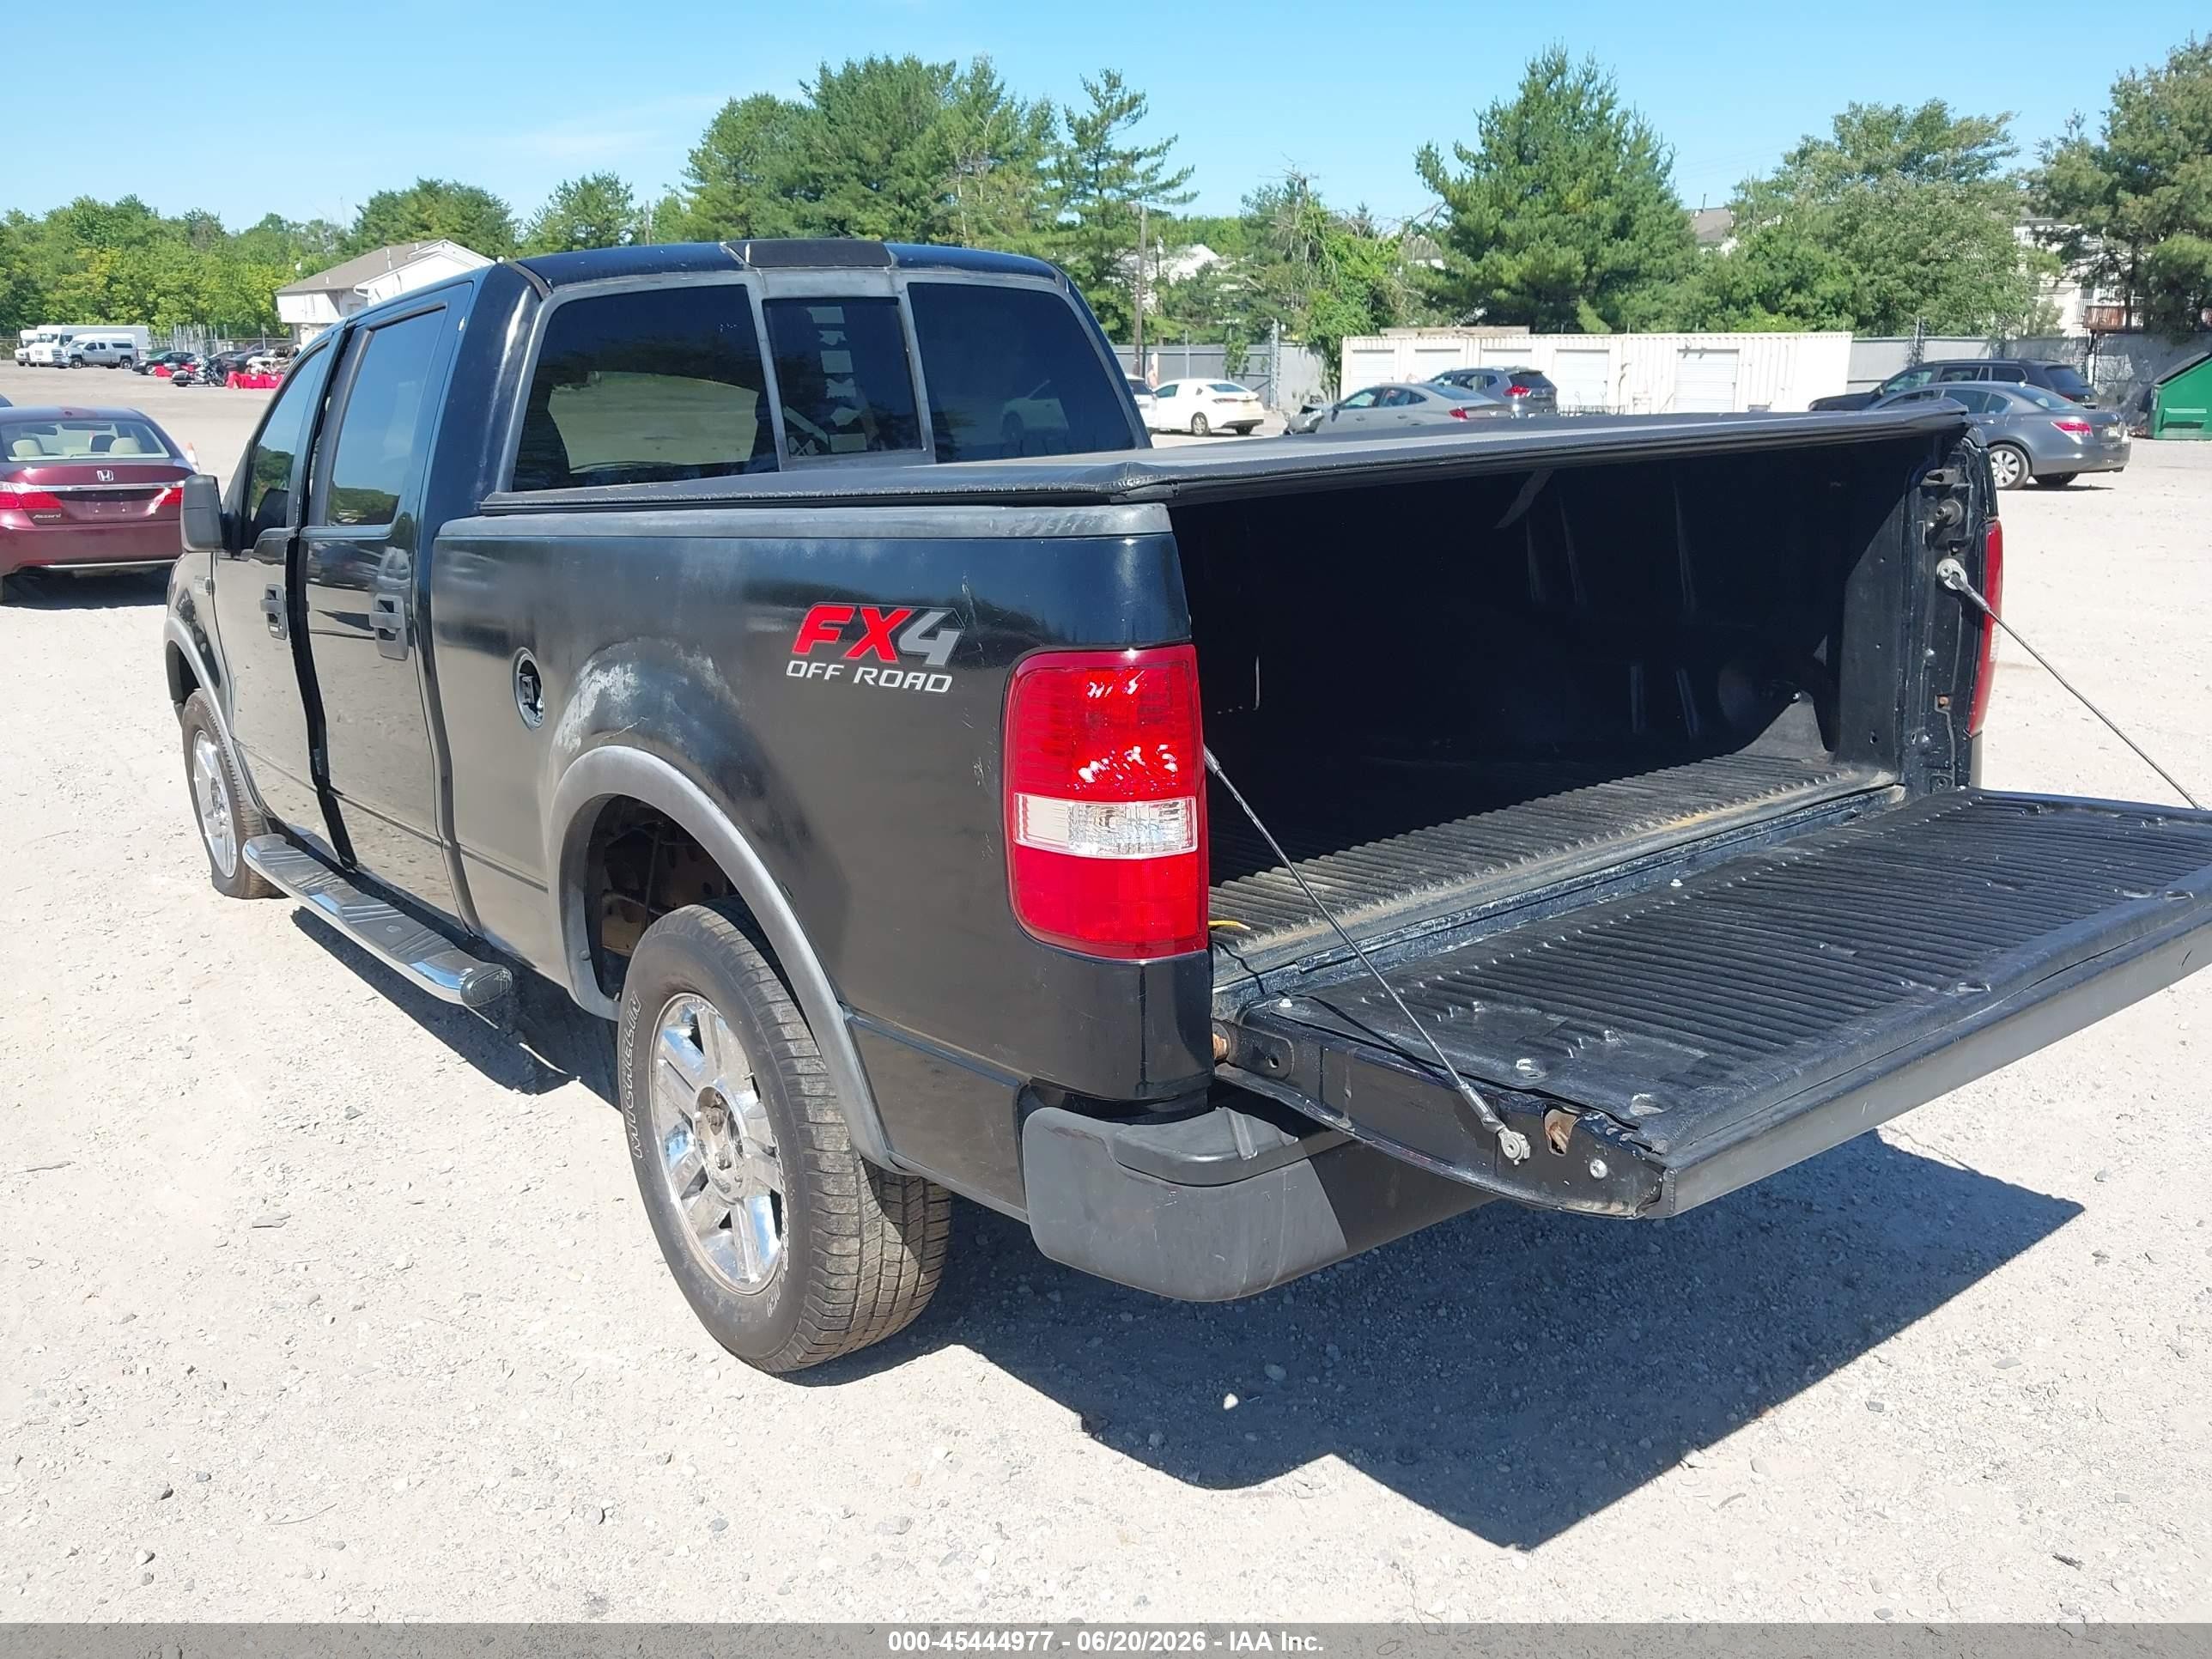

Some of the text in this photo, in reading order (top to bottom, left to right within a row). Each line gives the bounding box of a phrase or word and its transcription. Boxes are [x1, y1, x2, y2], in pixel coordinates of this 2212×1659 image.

[792, 604, 963, 667] FX4
[786, 660, 953, 693] OFF ROAD
[622, 991, 643, 1158] MICHELIN
